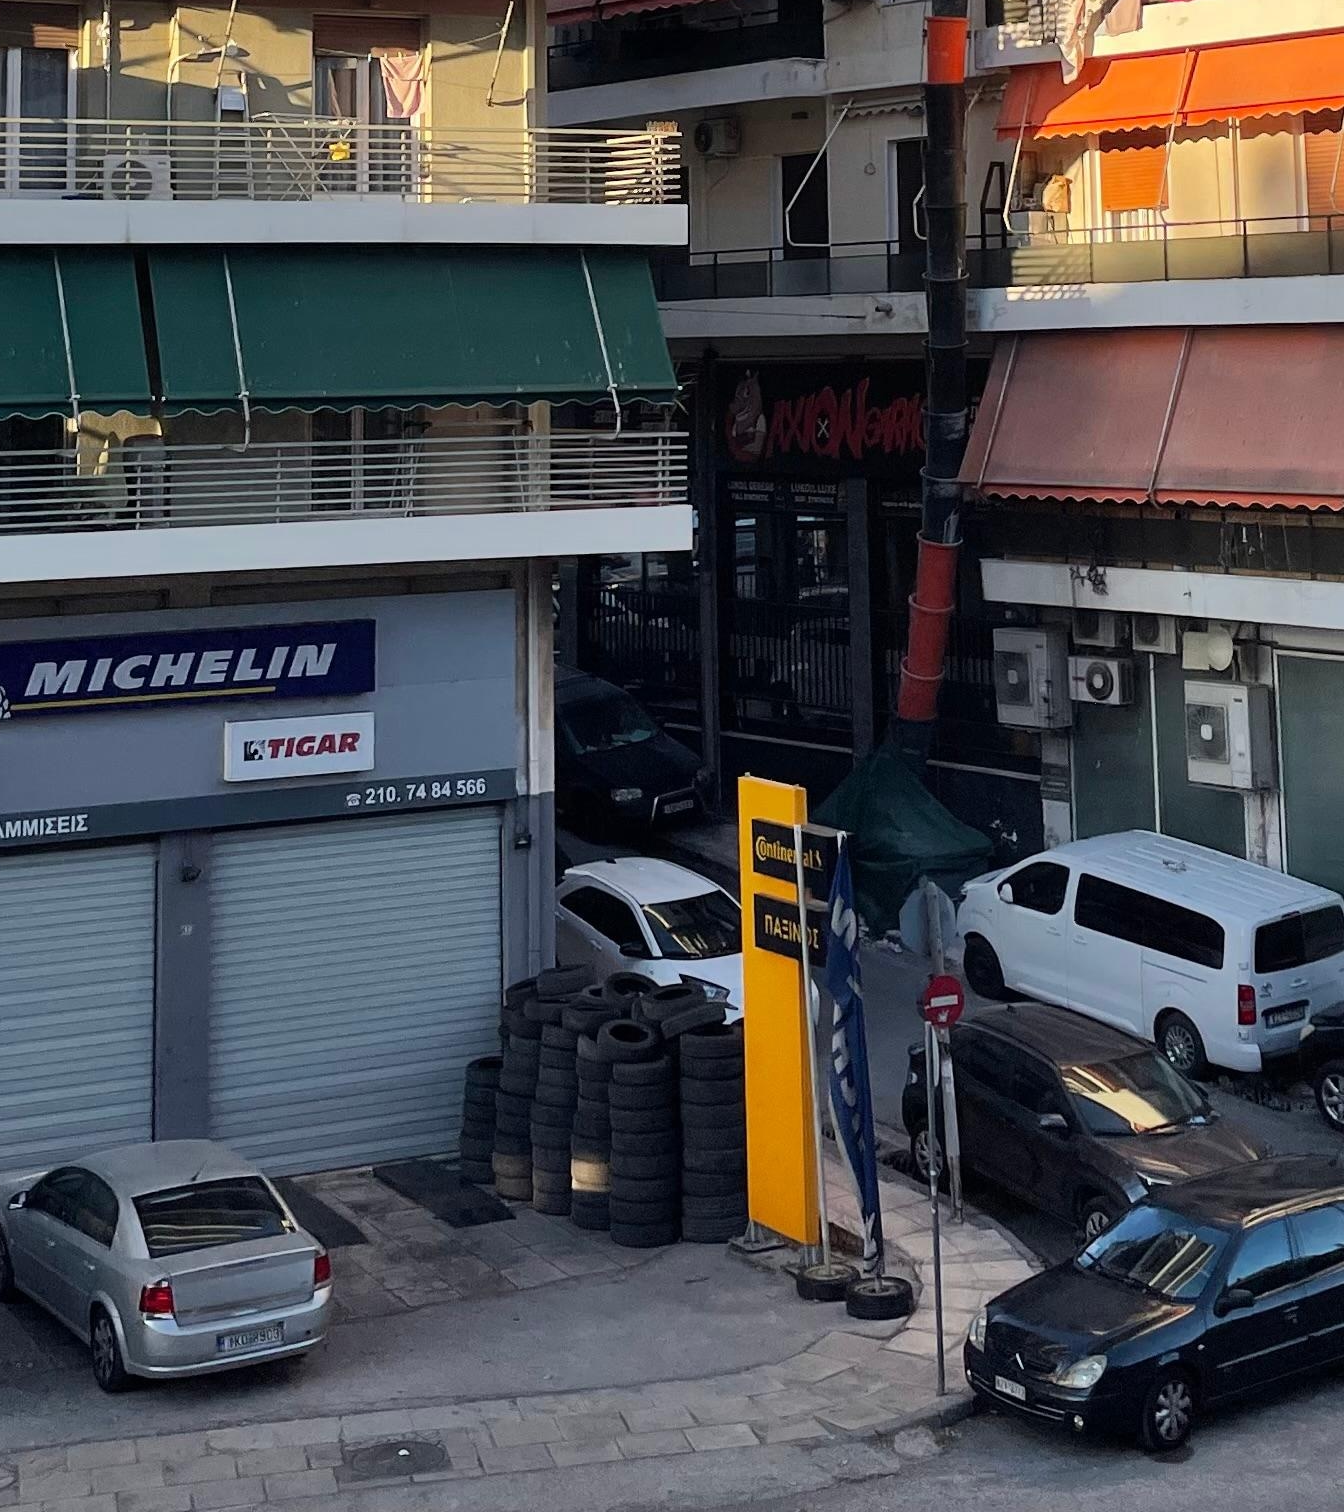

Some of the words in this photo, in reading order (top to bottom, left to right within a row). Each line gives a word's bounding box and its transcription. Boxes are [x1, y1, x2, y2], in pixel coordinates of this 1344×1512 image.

[23, 643, 337, 697] MICHELIN
[268, 732, 360, 759] TIGAR
[365, 786, 401, 805] 210.
[406, 783, 426, 801] 74
[431, 781, 451, 799] 84
[456, 778, 486, 796] 566
